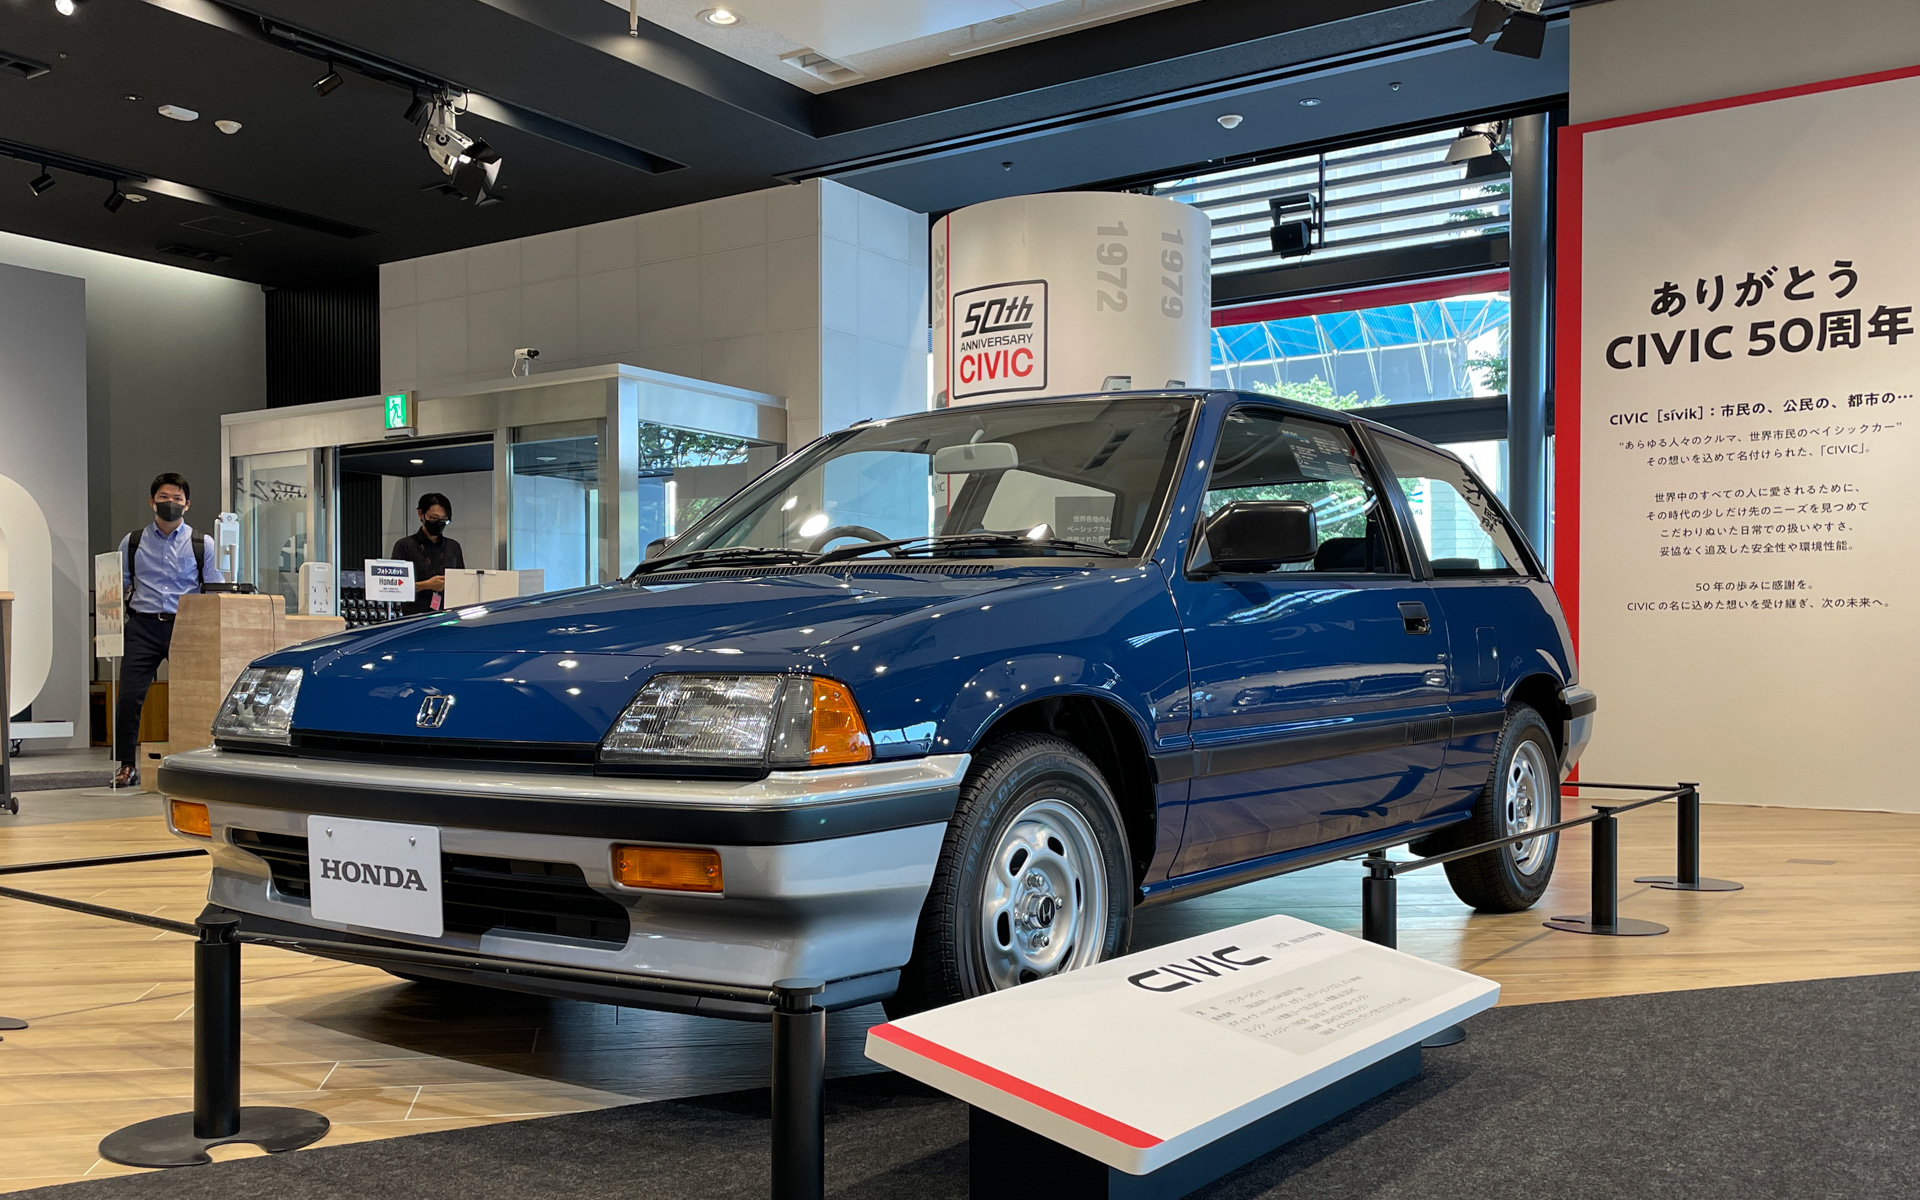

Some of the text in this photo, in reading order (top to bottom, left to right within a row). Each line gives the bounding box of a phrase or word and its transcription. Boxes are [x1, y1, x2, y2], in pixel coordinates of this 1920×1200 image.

[934, 243, 946, 331] 2021
[1096, 220, 1129, 313] 1972
[1160, 228, 1185, 320] 1979
[1650, 259, 1858, 318] ありがとう
[960, 295, 1035, 339] 50th
[1605, 304, 1914, 370] CIVIC 50周年
[960, 333, 1034, 353] ANNIVERSARY
[959, 347, 1034, 385] CIVIC
[1646, 501, 1869, 521] その時代の少しだけ先のニーズを見つめて
[1654, 483, 1860, 503] 世界中のすべての人に愛されるために、
[1660, 521, 1853, 538] こだわりぬいた日常での扱いやすさ、
[378, 577, 398, 586] Honda
[319, 857, 428, 892] HONDA
[1127, 945, 1272, 993] CIVIC
